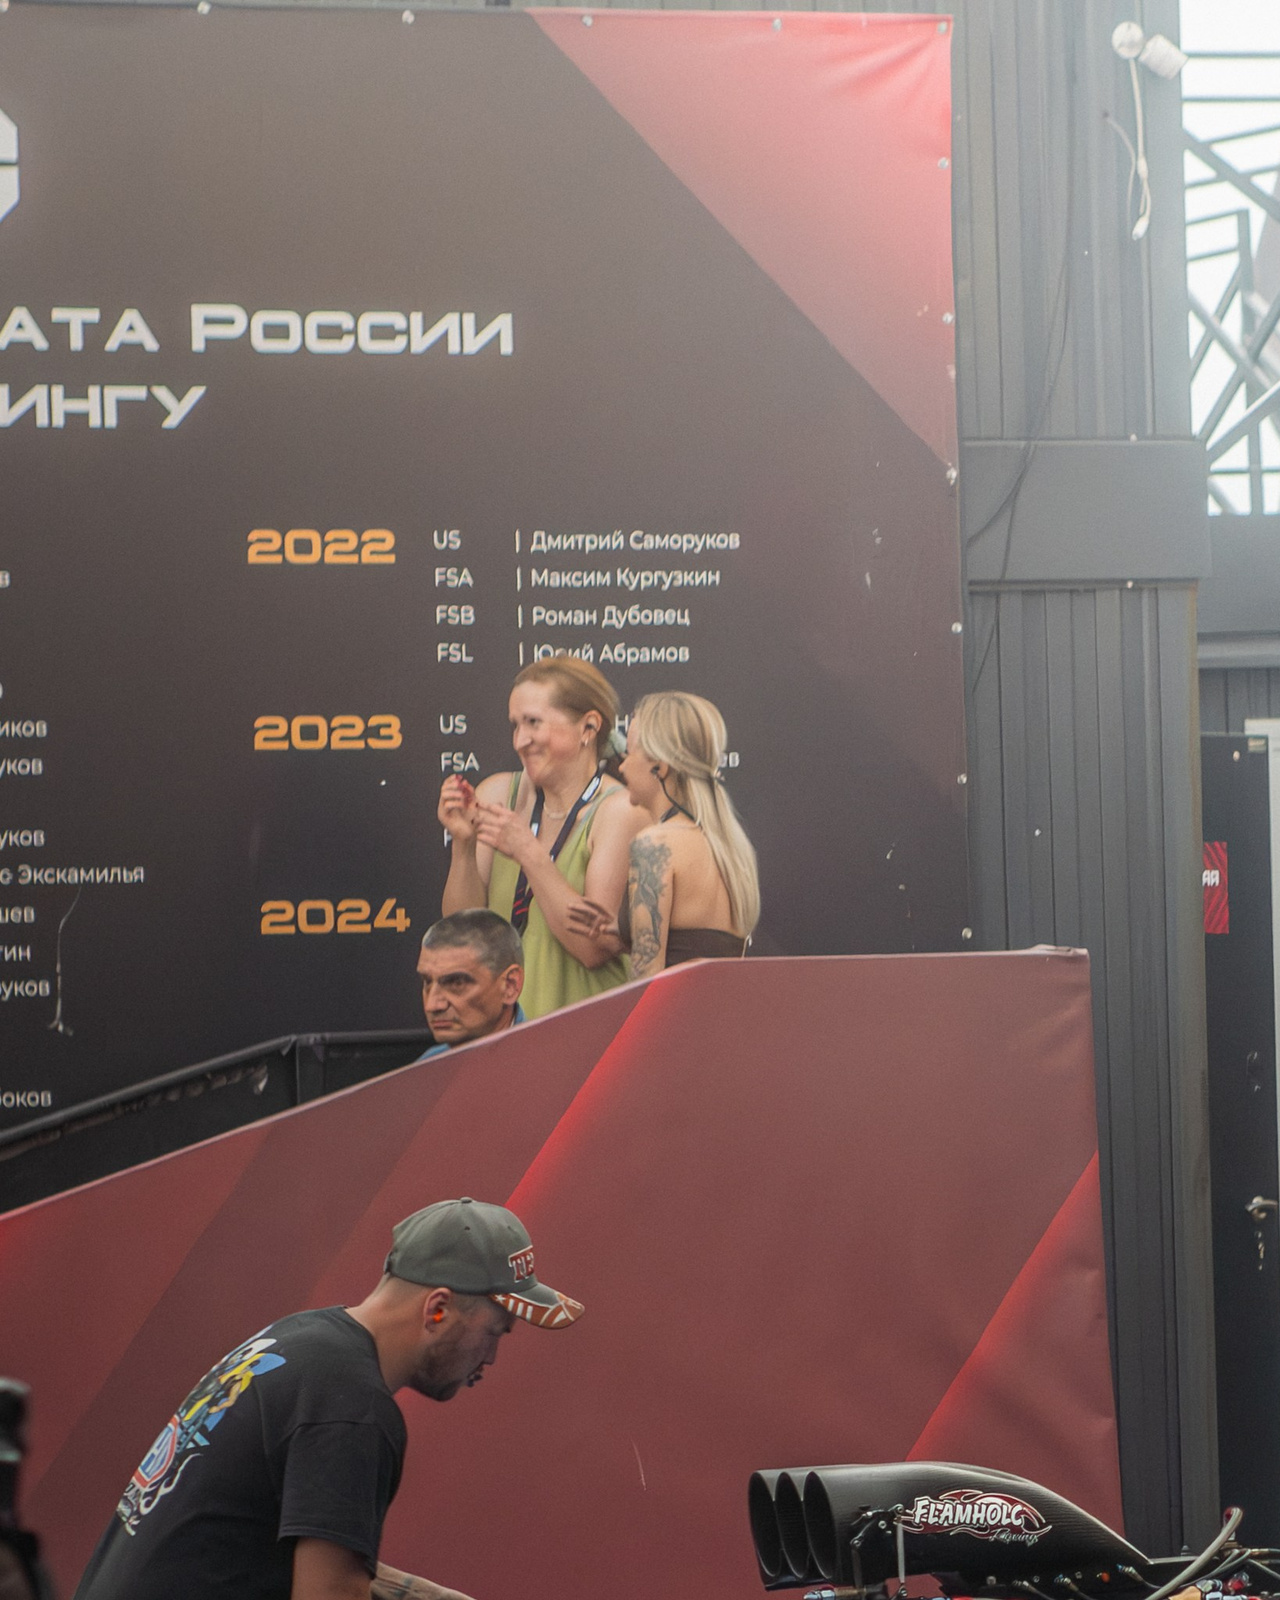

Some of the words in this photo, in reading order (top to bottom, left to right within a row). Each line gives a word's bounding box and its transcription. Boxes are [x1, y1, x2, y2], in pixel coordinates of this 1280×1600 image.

[247, 529, 396, 564] 2022
[433, 530, 461, 549] US
[530, 529, 624, 554] Дмитрий
[629, 530, 740, 554] Саморуков
[435, 568, 474, 587] FSA
[531, 568, 611, 587] Максим
[616, 568, 721, 591] Кургузкин
[436, 605, 475, 625] FSB
[532, 606, 597, 625] Роман
[602, 604, 691, 629] Дубовец
[437, 643, 474, 663] FSL
[599, 643, 690, 667] Абрамов
[253, 714, 403, 751] 2023
[440, 714, 467, 734] US
[441, 752, 480, 772] FSA
[18, 864, 145, 885] Экскамилья
[260, 898, 411, 935] 2024
[914, 1497, 1024, 1527] FLAMHOLC
